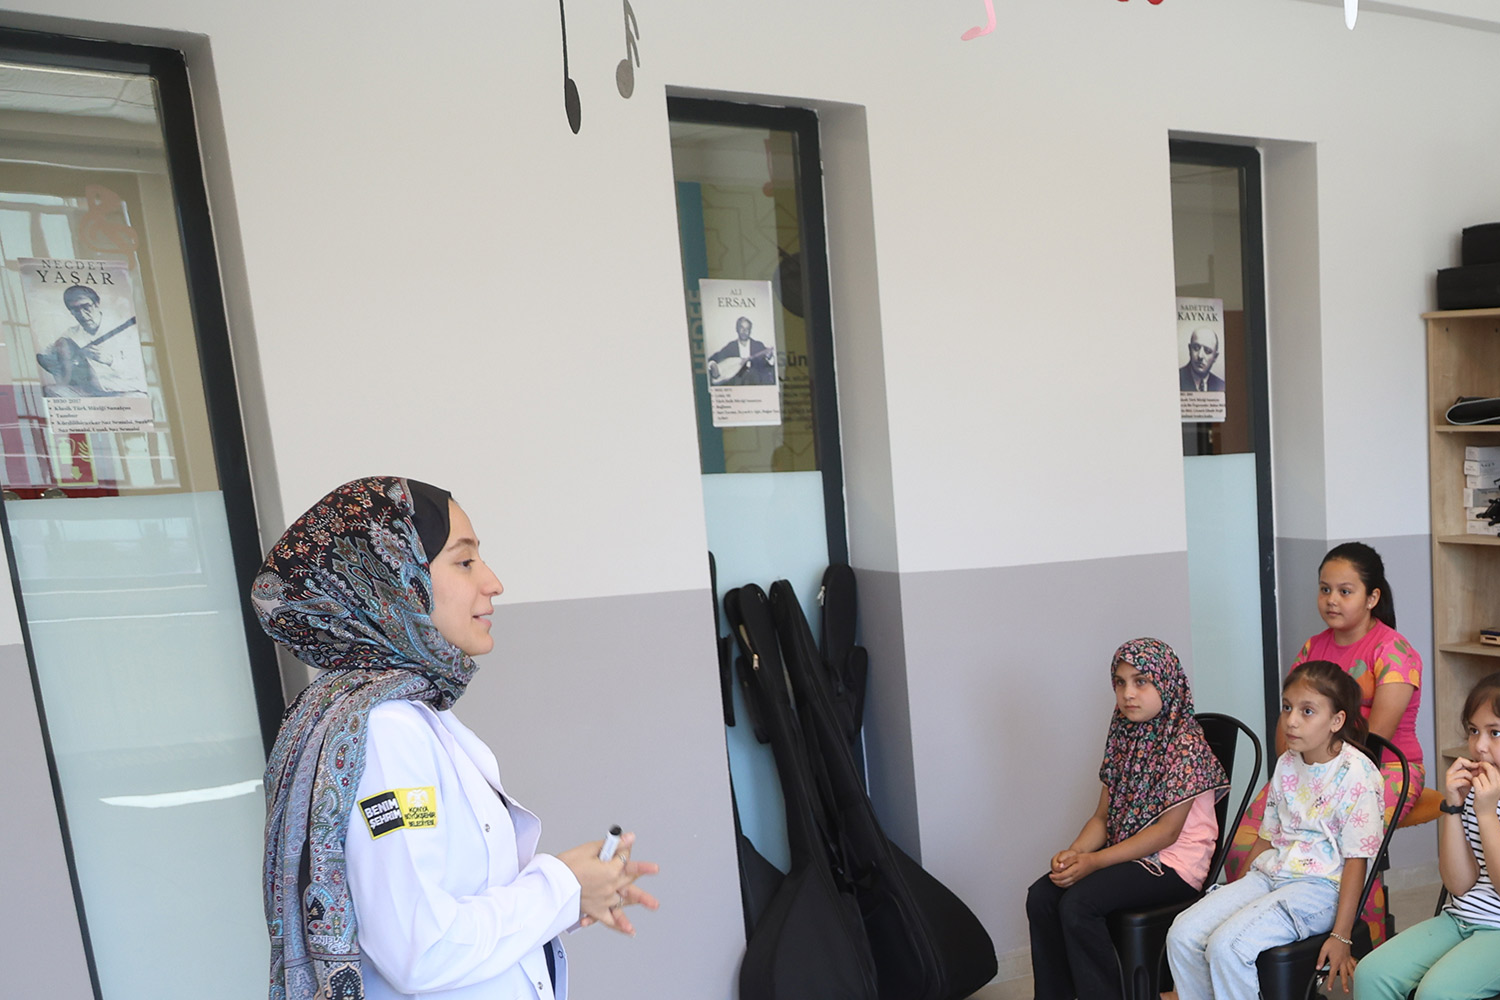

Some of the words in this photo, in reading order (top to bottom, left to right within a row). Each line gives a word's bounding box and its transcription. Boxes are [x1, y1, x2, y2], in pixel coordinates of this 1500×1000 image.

[41, 259, 107, 271] NECDET
[36, 269, 115, 287] YAŞAR
[717, 297, 756, 308] ERSAN
[1177, 311, 1219, 322] KAYNAK
